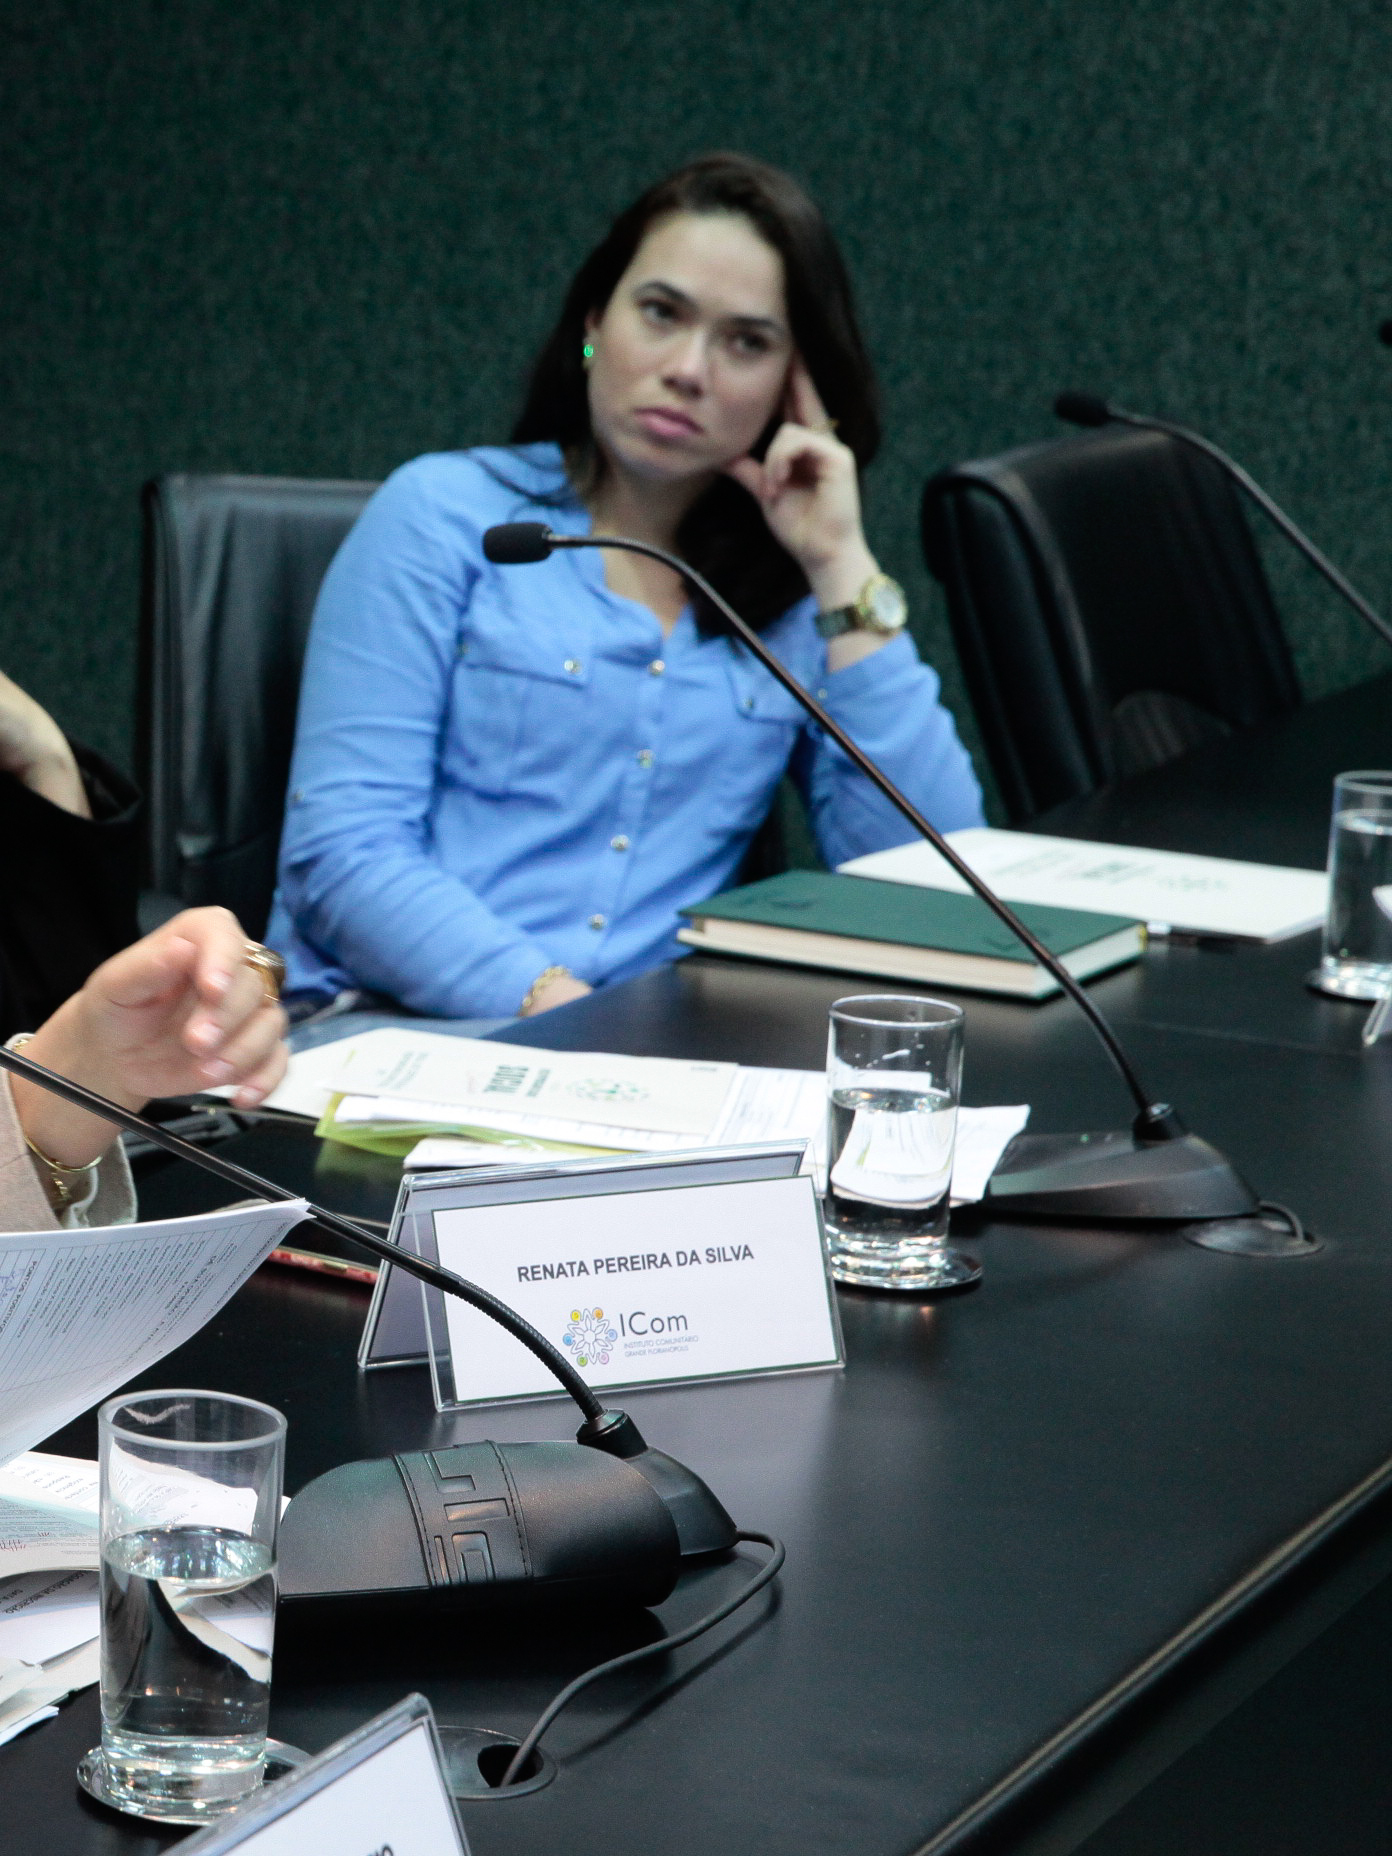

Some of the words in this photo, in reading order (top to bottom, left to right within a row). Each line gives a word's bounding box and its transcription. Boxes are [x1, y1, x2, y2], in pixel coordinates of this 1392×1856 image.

[16, 1260, 38, 1293] PONTOS
[517, 1260, 590, 1283] RENATA
[594, 1252, 672, 1275] PEREIRA
[676, 1249, 702, 1267] DA
[705, 1244, 755, 1264] SILVA
[620, 1311, 688, 1337] ICom
